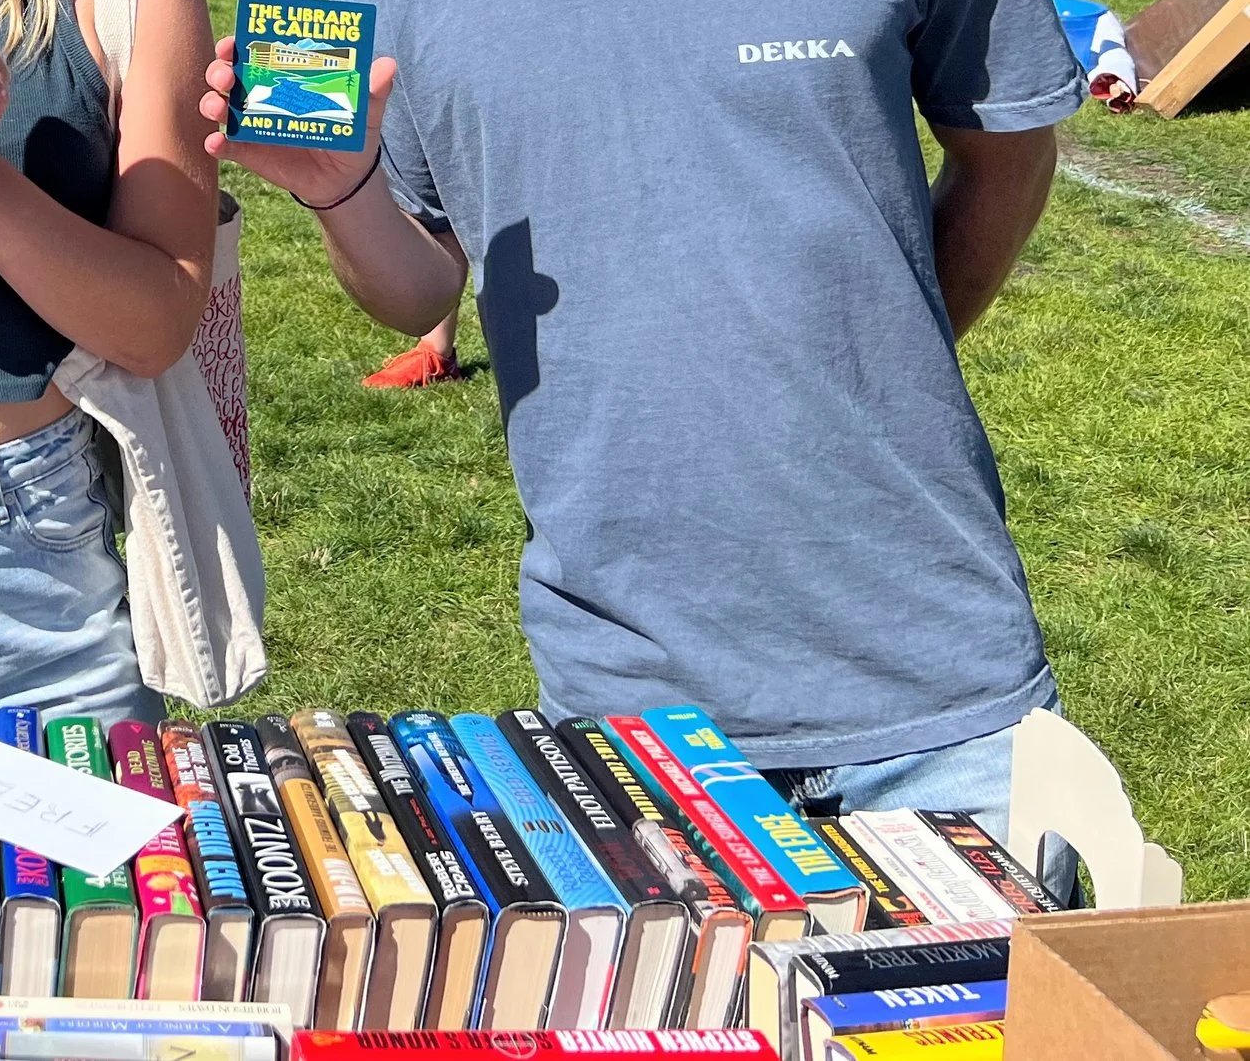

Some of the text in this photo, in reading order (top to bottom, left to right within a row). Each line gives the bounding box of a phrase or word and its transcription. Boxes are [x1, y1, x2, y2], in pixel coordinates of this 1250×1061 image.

[248, 3, 363, 26] THE LIBRARY
[247, 17, 361, 42] IS CALLING
[737, 39, 855, 64] DEKKA
[240, 115, 354, 136] AND I MUST GO
[62, 724, 93, 775] STORIES
[187, 741, 206, 765] DOOR
[222, 743, 242, 766] Odd
[240, 738, 261, 772] Thomas
[585, 733, 619, 761] SMITH
[128, 751, 144, 775] DEAD
[142, 739, 165, 789] RECKONING
[172, 746, 194, 785] THE WOLF
[194, 763, 211, 782] THE
[367, 735, 414, 795] THE WATCHMAN
[475, 733, 538, 806] COLD SERVICE
[606, 761, 636, 785] CRUZ
[630, 730, 702, 795] MICHAEL PALMER
[532, 735, 617, 829] ELIOT PATTISON
[623, 785, 664, 820] MARTIN
[188, 800, 247, 899] JACK HIGGINS
[471, 809, 529, 888] STEVE BERRY
[692, 800, 778, 886] THE LAST SURGEON
[753, 812, 841, 876] THE EDGE
[244, 816, 310, 902] KOONTZ
[964, 849, 1004, 876] ILES
[425, 852, 456, 900] ROBERT
[440, 851, 476, 897] CRAIS
[868, 877, 890, 893] THE
[987, 850, 1047, 900] QUIET GAME
[269, 897, 311, 910] DEAN
[865, 949, 913, 971] PREY
[914, 942, 1002, 969] MORTAL
[872, 983, 981, 1009] TAKEN
[558, 1029, 761, 1053] STEPHEN HUNTER
[903, 1020, 1000, 1048] FRANCIS
